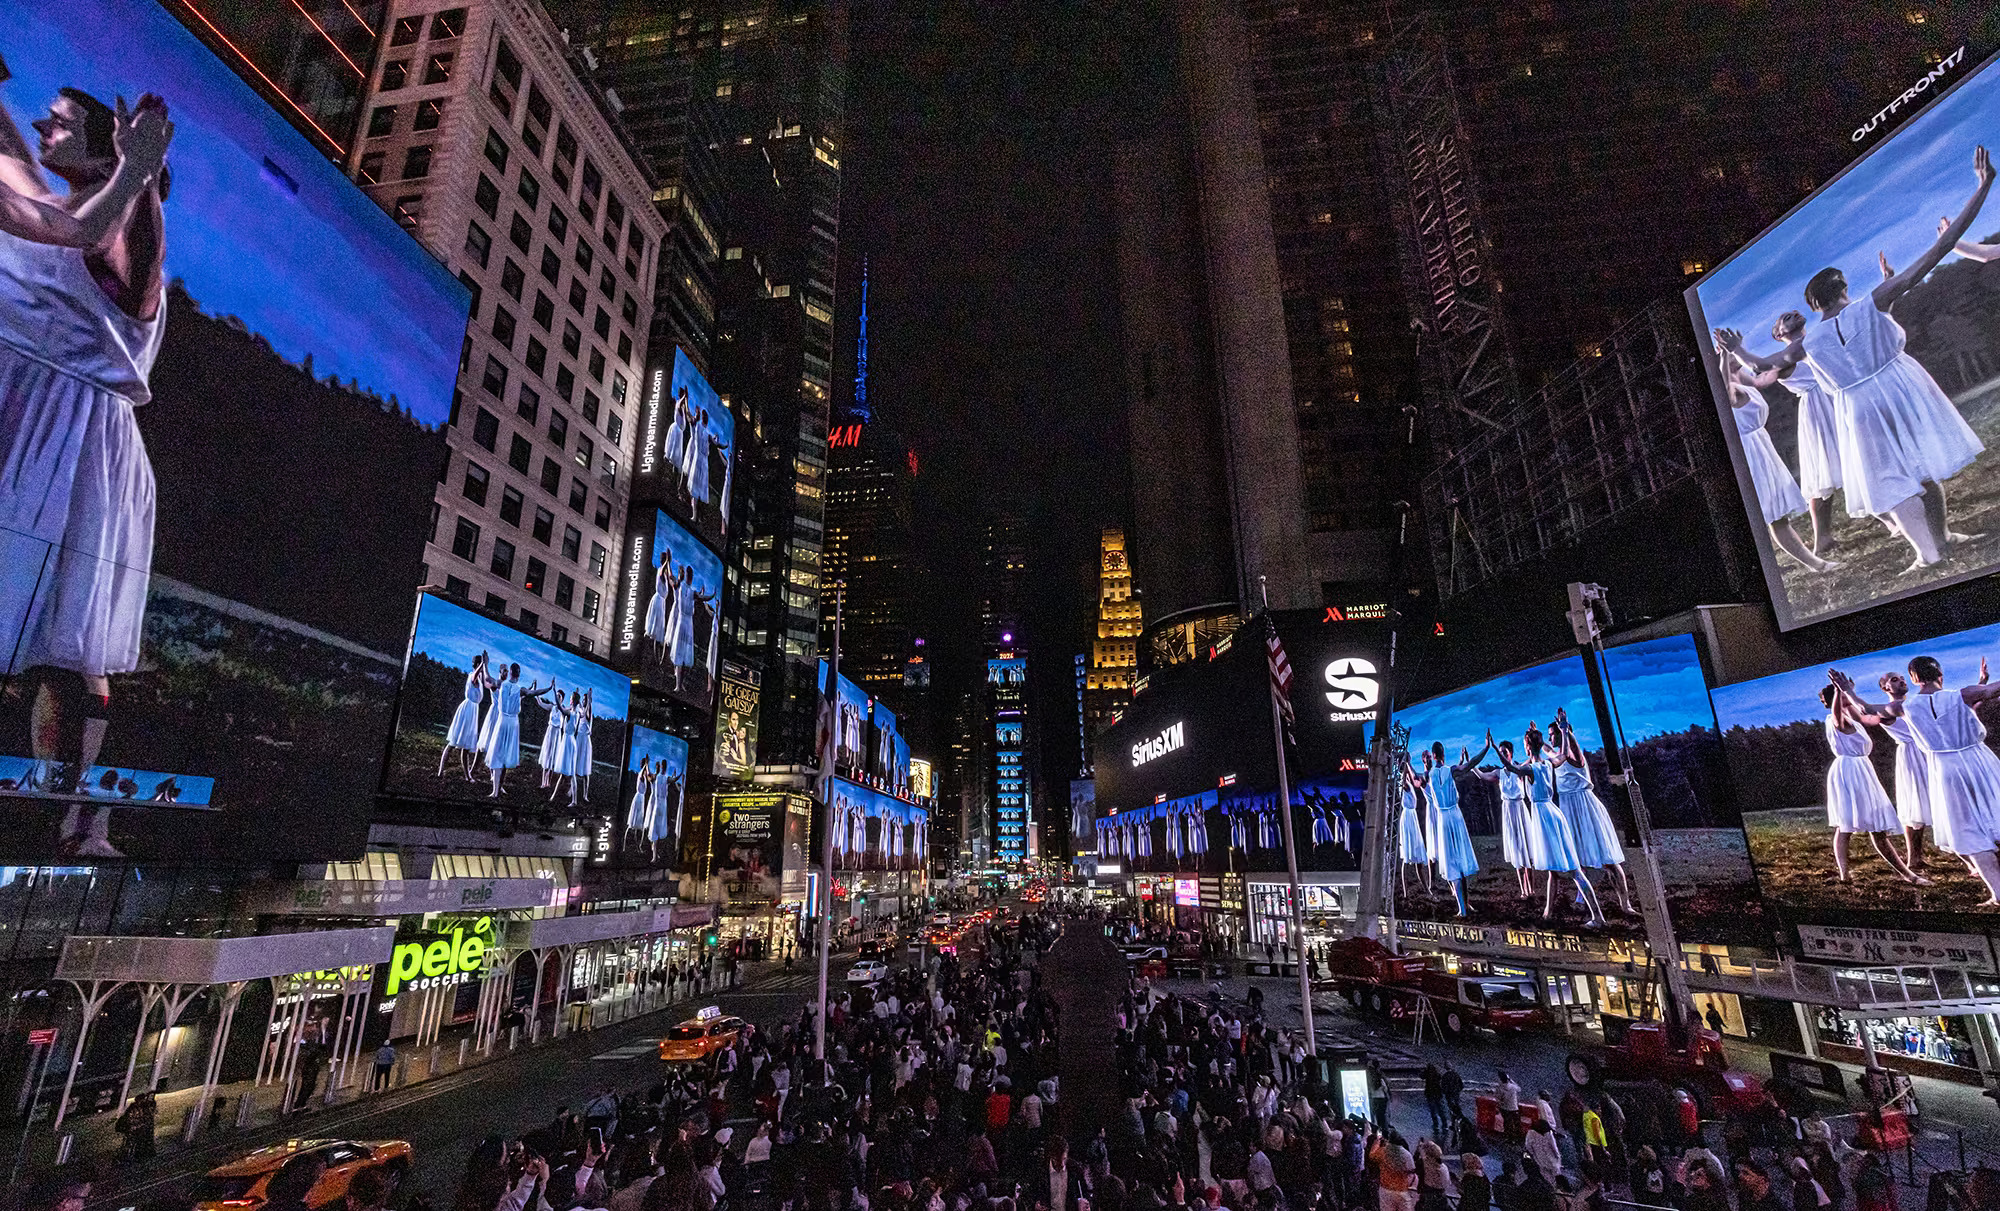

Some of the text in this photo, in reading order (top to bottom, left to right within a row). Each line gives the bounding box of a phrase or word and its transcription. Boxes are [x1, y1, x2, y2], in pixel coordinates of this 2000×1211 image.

[641, 370, 662, 473] Lightyearmedia.com
[828, 424, 863, 448] H&M
[620, 536, 643, 650] Lightyearmedia.com
[721, 680, 735, 696] THE
[735, 686, 760, 704] GREAT
[724, 695, 755, 713] GATSBY
[1131, 721, 1184, 767] SiriusXM
[729, 820, 770, 831] strangers
[733, 812, 749, 822] two
[594, 816, 612, 861] Lghty
[1823, 927, 1920, 943] SPORTS FAN SHOP
[409, 972, 470, 992] SOCCER
